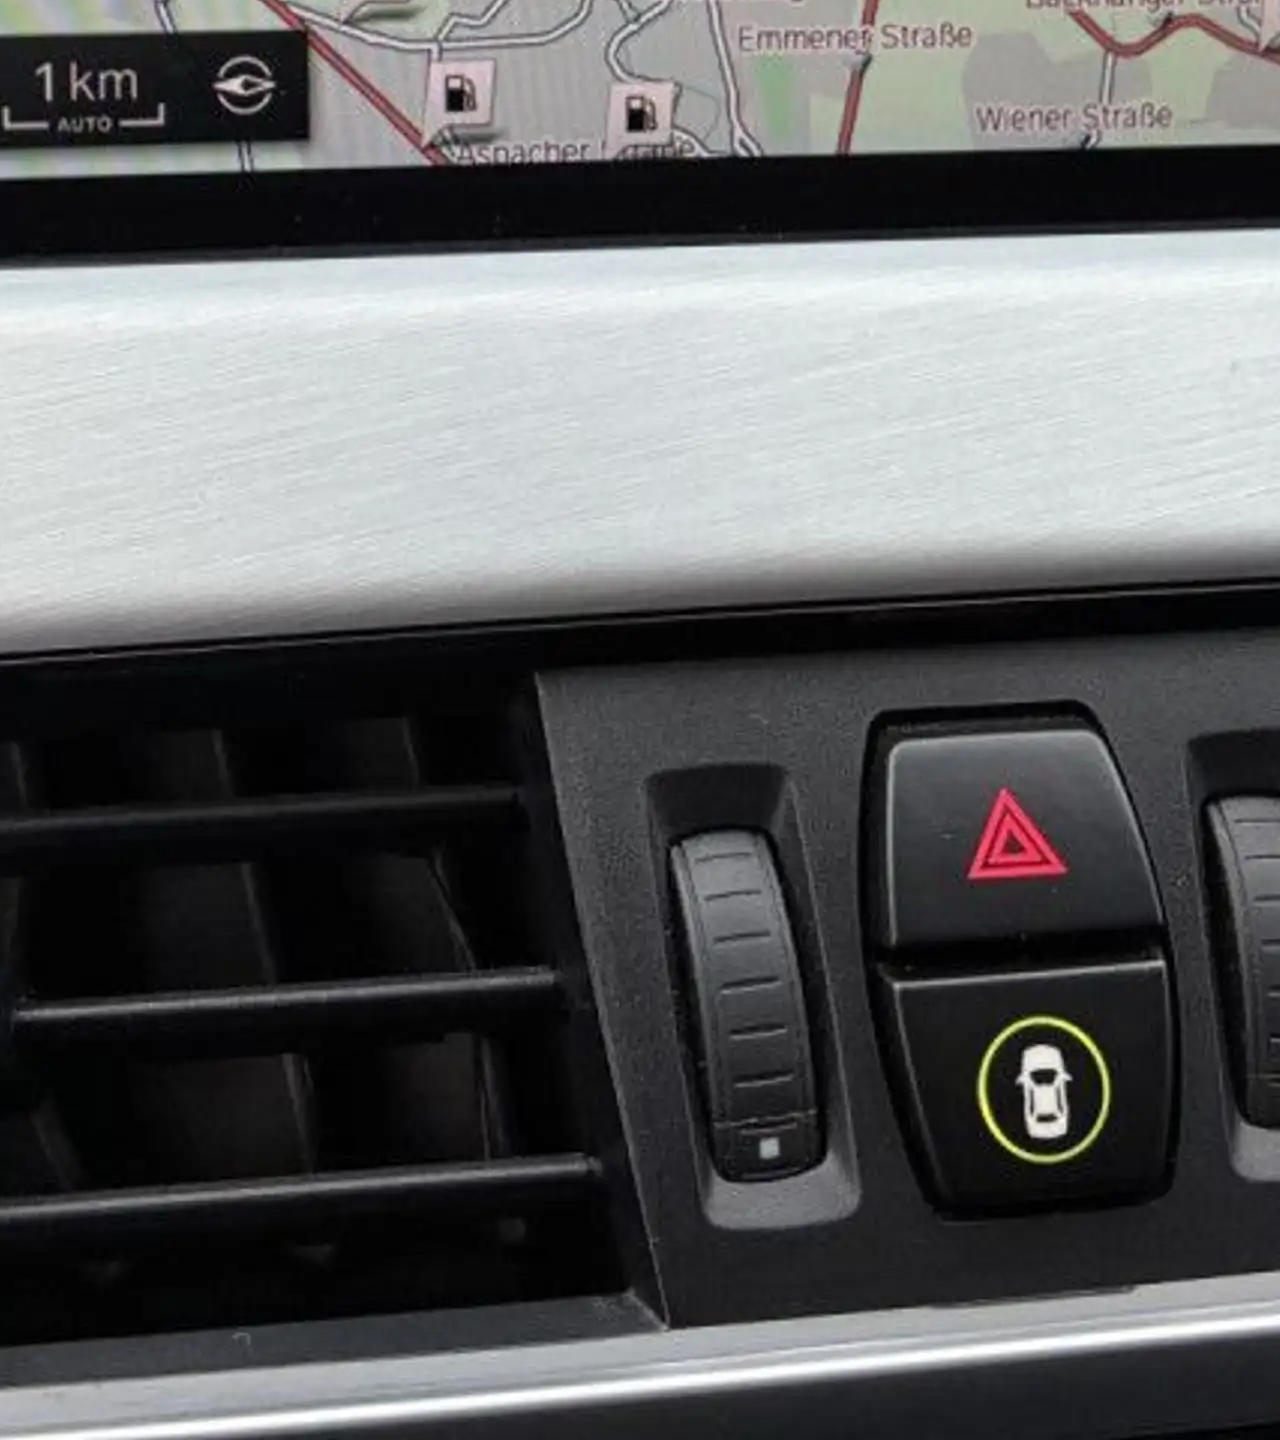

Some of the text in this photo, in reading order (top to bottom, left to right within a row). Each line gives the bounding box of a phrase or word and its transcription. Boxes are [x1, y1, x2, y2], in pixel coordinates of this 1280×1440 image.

[882, 22, 972, 49] Straße
[35, 60, 138, 102] 1 km
[58, 115, 114, 133] AUTO
[976, 103, 1172, 132] Wiener Straße
